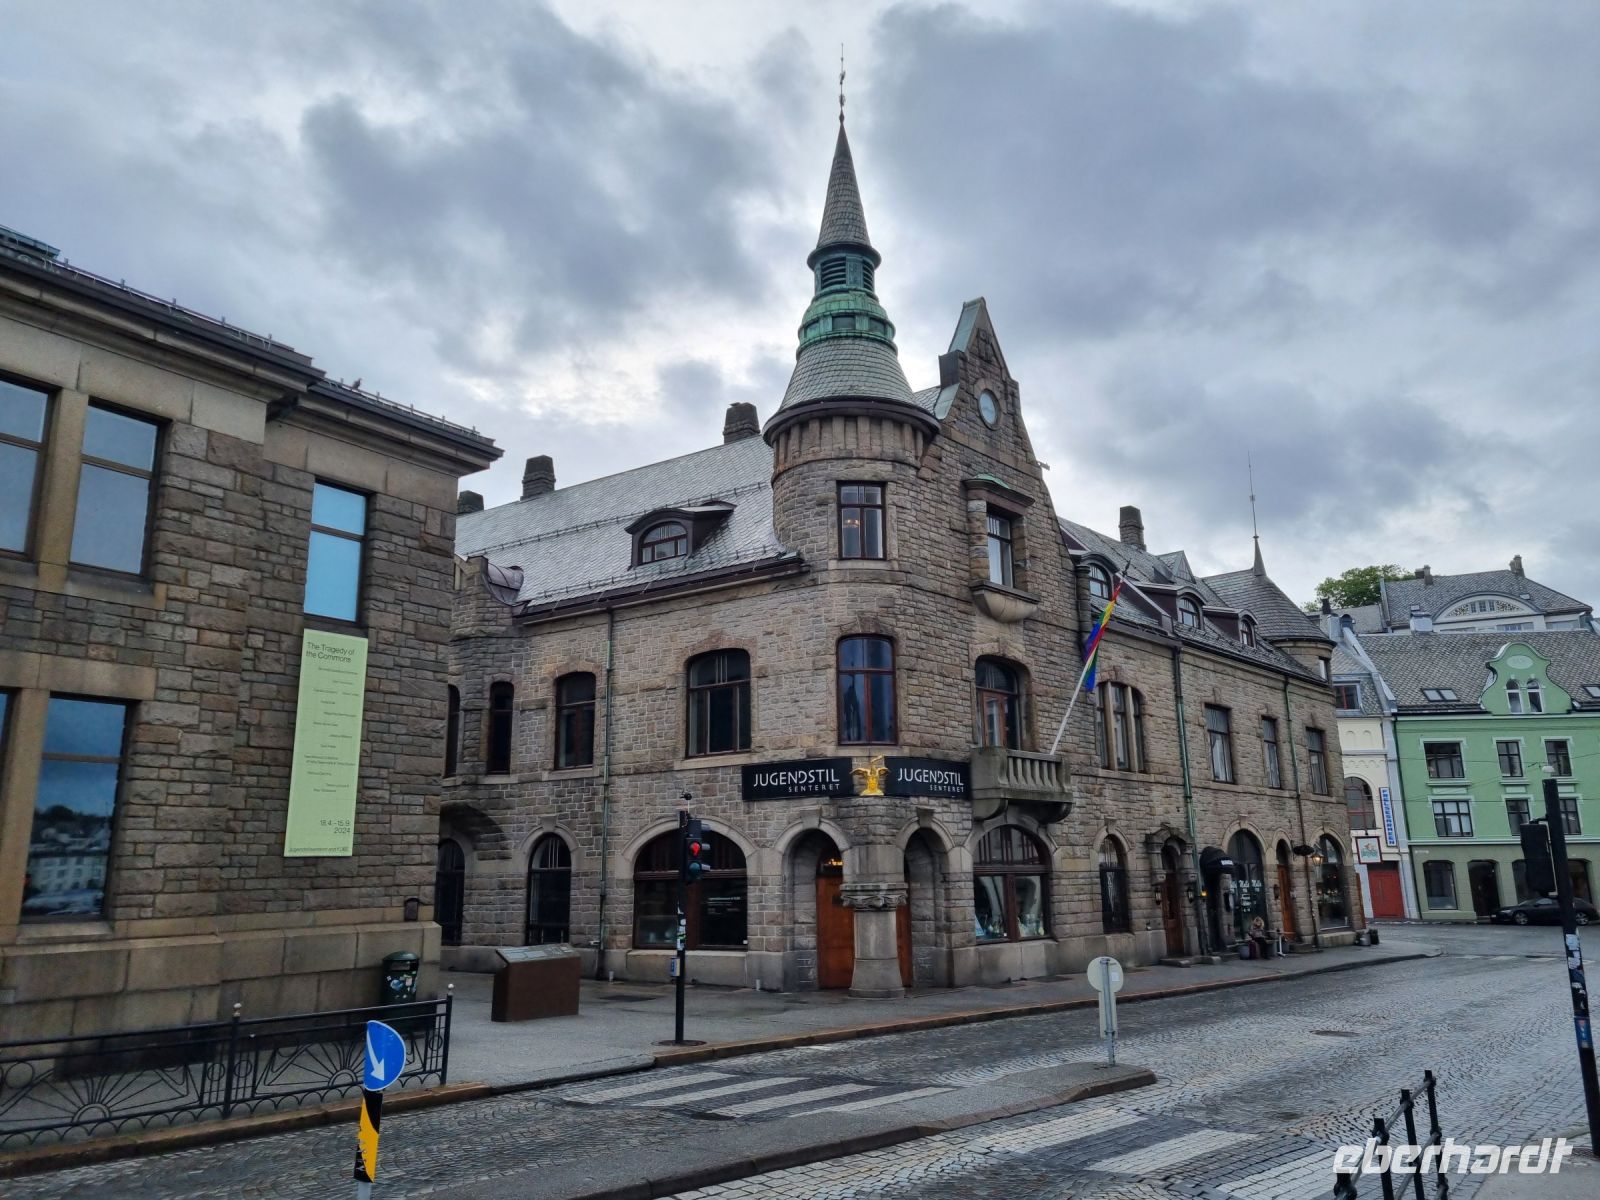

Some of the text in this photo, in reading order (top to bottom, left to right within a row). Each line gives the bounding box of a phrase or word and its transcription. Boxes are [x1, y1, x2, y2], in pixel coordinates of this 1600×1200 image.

[306, 641, 320, 651] The
[321, 644, 347, 656] Tragedy
[305, 650, 352, 663] the Commons
[753, 768, 840, 787] JUGENDSTIL
[897, 767, 964, 786] JUGENDSTIL
[788, 783, 840, 793] SENTERET
[929, 784, 964, 793] SENTERET
